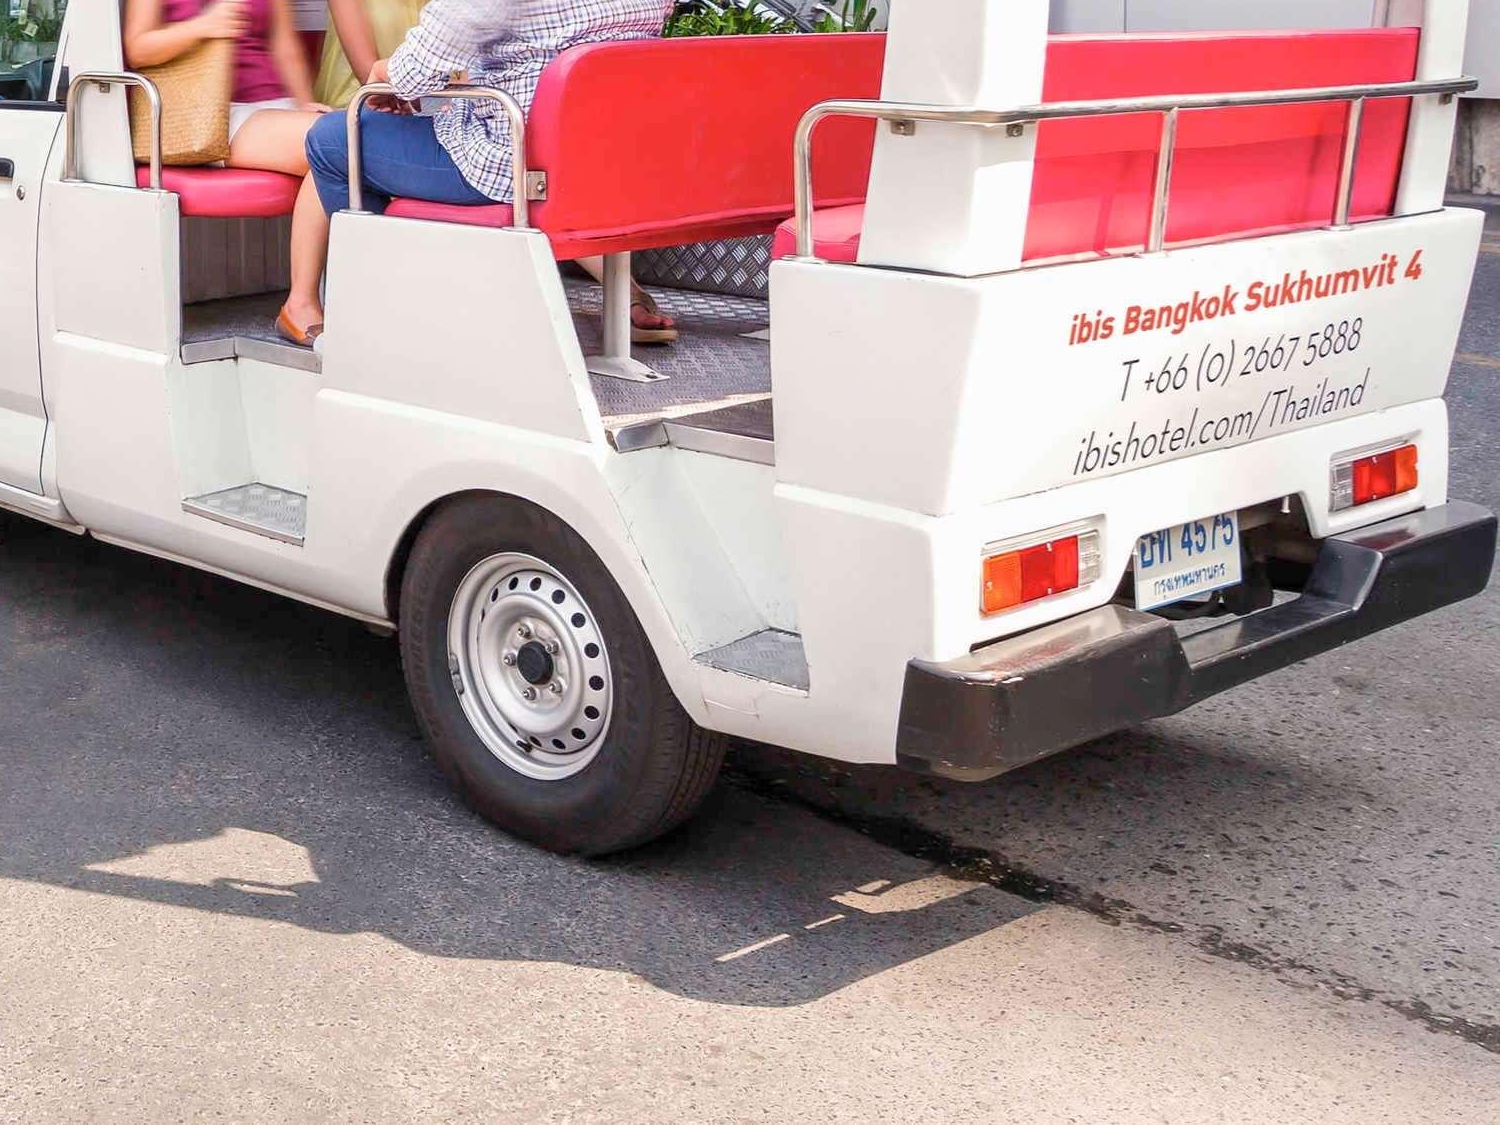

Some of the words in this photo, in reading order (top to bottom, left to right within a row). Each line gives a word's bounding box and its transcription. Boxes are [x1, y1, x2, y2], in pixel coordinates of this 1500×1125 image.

[1069, 310, 1114, 345] ibis
[1122, 285, 1239, 336] Bangkok
[1245, 253, 1398, 311] Sukhumvit
[1404, 250, 1424, 280] 4
[1121, 359, 1140, 401] T
[1144, 353, 1189, 393] +66
[1240, 335, 1300, 376] 2667
[1302, 317, 1364, 366] 5888
[1073, 367, 1371, 476] ibishotel.com/Thailand
